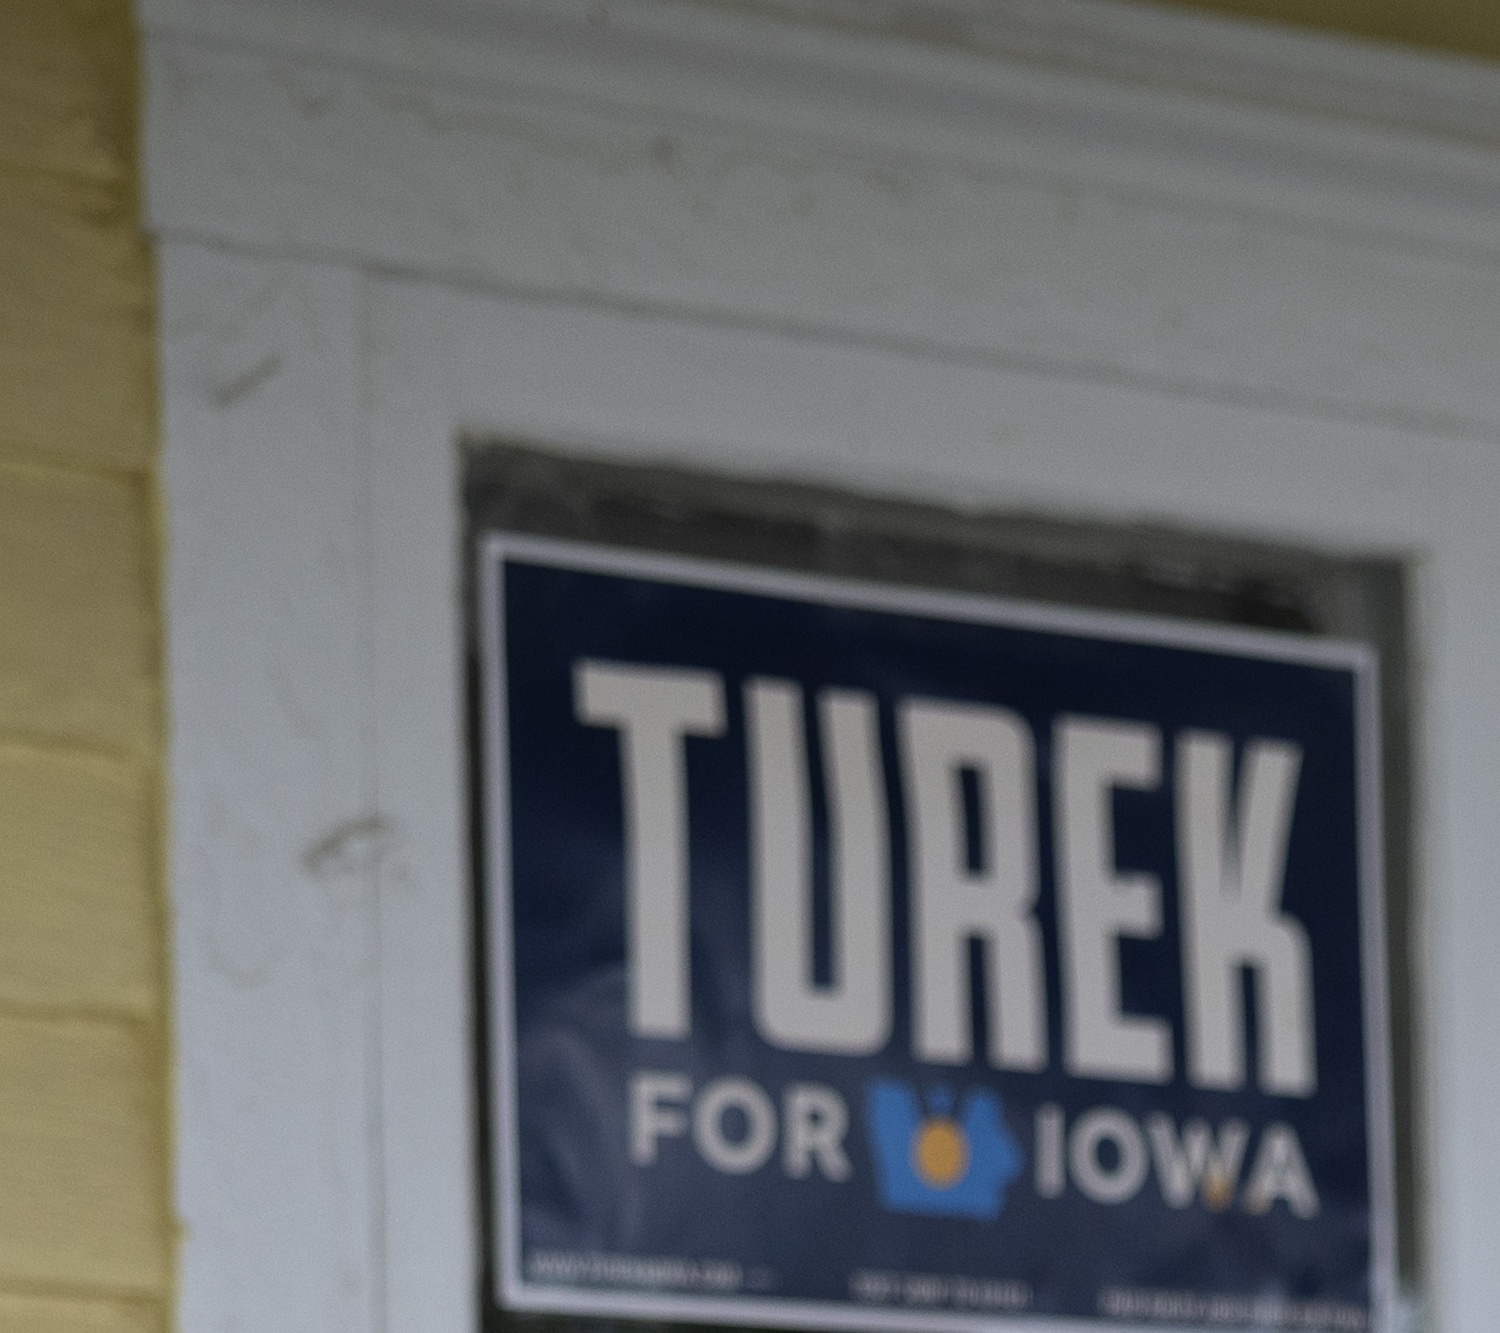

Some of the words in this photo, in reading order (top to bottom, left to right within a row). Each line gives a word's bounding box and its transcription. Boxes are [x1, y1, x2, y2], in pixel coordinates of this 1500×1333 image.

[574, 659, 1317, 1094] TUREK
[630, 1075, 849, 1180] FOR
[1036, 1105, 1319, 1216] IOWA
